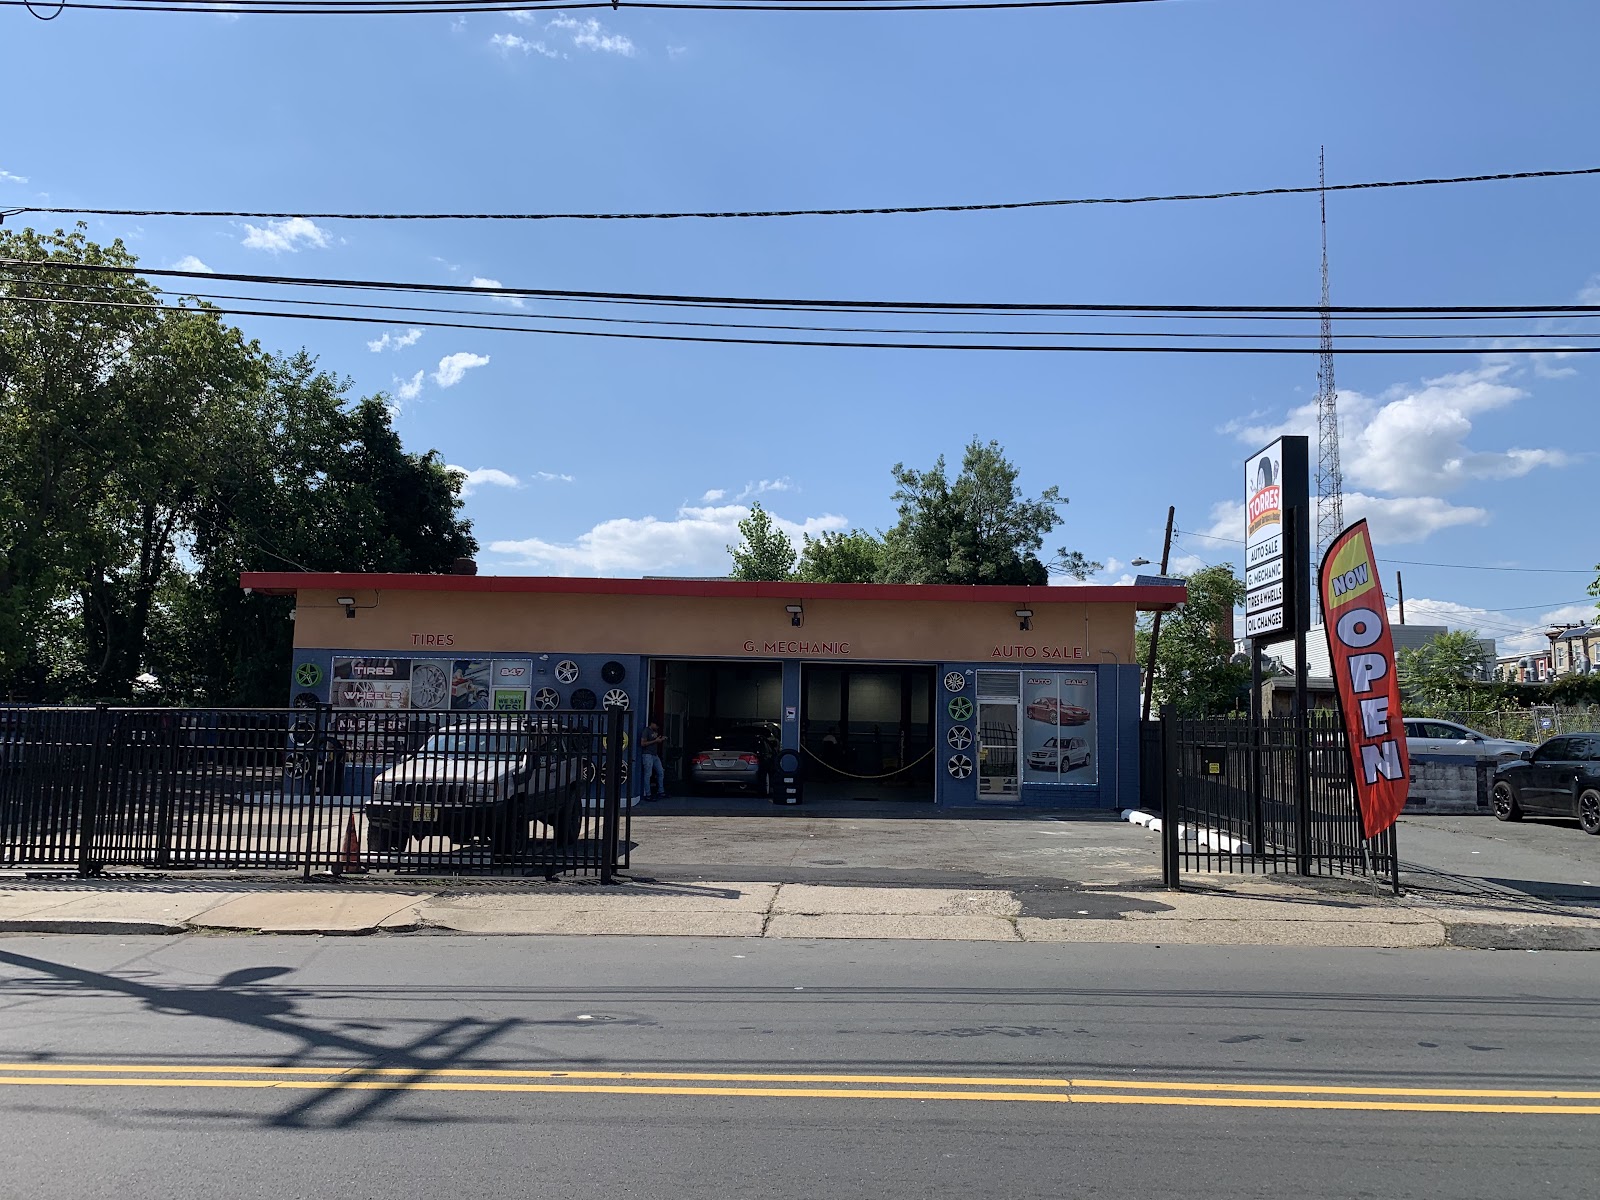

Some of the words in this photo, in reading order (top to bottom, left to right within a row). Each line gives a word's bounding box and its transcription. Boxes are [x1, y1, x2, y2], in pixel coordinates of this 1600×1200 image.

[1250, 489, 1278, 520] TORRES
[1251, 546, 1264, 562] AUTO
[1265, 540, 1278, 556] SALE
[1248, 574, 1253, 586] G.
[1254, 564, 1281, 583] MECHANIC
[1332, 561, 1368, 597] NOW
[1248, 595, 1259, 609] TIRES
[1248, 618, 1256, 632] OIL
[1257, 612, 1282, 629] CHANGES
[412, 633, 454, 646] TIRES
[743, 640, 758, 652] G.
[764, 641, 850, 654] MECHANIC
[992, 645, 1037, 658] AUTO
[1042, 646, 1083, 659] SALE
[354, 666, 394, 676] TIRES
[500, 668, 525, 676] 847
[344, 691, 402, 700] WHEELS
[1336, 607, 1405, 786] OPEN
